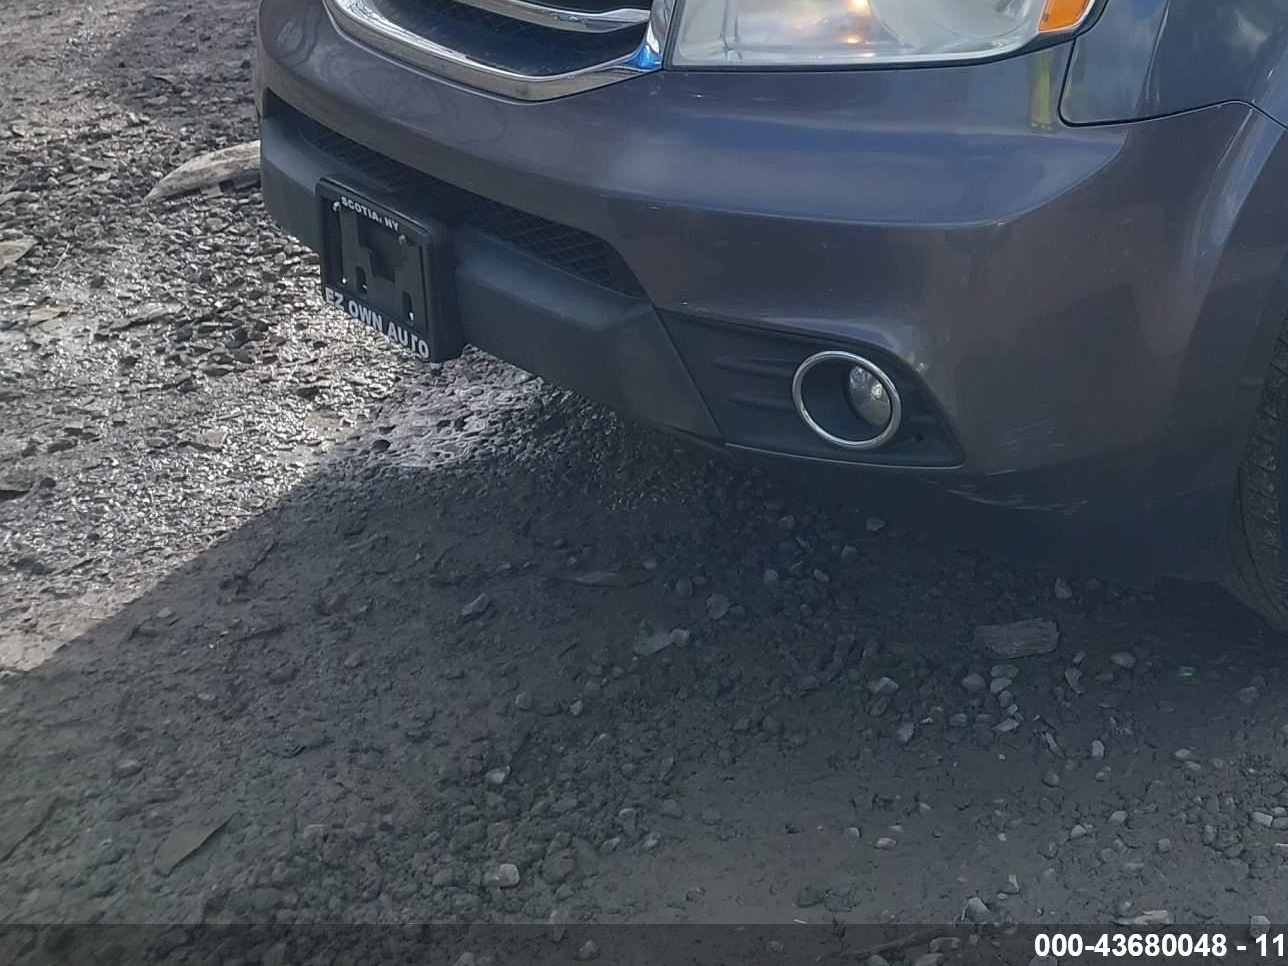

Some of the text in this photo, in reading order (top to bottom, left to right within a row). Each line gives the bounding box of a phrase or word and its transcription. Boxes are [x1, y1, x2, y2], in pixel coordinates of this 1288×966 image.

[384, 218, 400, 232] NY
[325, 287, 430, 360] EZ OWN AUTO
